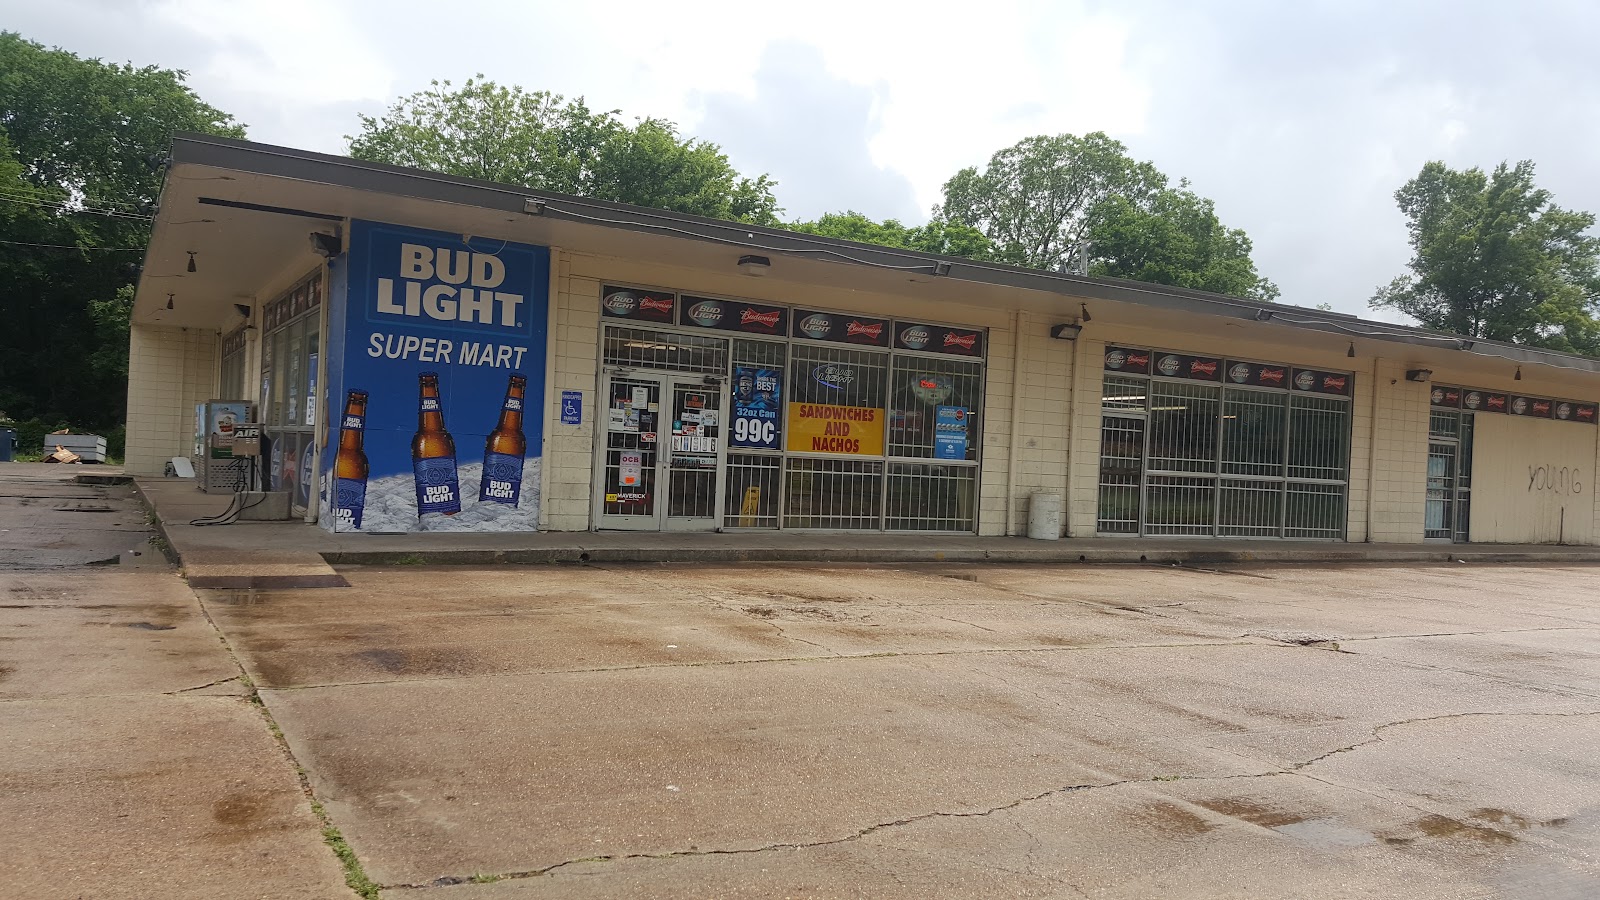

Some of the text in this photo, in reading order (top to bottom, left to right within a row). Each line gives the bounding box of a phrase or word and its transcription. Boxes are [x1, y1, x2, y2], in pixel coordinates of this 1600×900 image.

[400, 243, 505, 288] BUD
[377, 278, 523, 327] LIGHT
[608, 301, 635, 310] LIGHT
[694, 311, 723, 320] LIGHT
[810, 318, 828, 326] BUD
[804, 324, 830, 332] LIGHT
[904, 335, 929, 343] LIGHT
[367, 332, 527, 369] SUPER MART
[756, 382, 776, 392] BEST
[737, 408, 775, 418] 32oz Can
[800, 405, 874, 422] SANDWICHES
[344, 421, 362, 429] LIGHT
[824, 422, 850, 436] AND
[234, 430, 259, 438] AIR
[735, 418, 774, 444] 99¢
[812, 436, 859, 452] NACHOS
[490, 480, 511, 490] BUD
[426, 486, 450, 495] BUD
[486, 488, 514, 498] LIGHT
[423, 492, 454, 503] LIGHT
